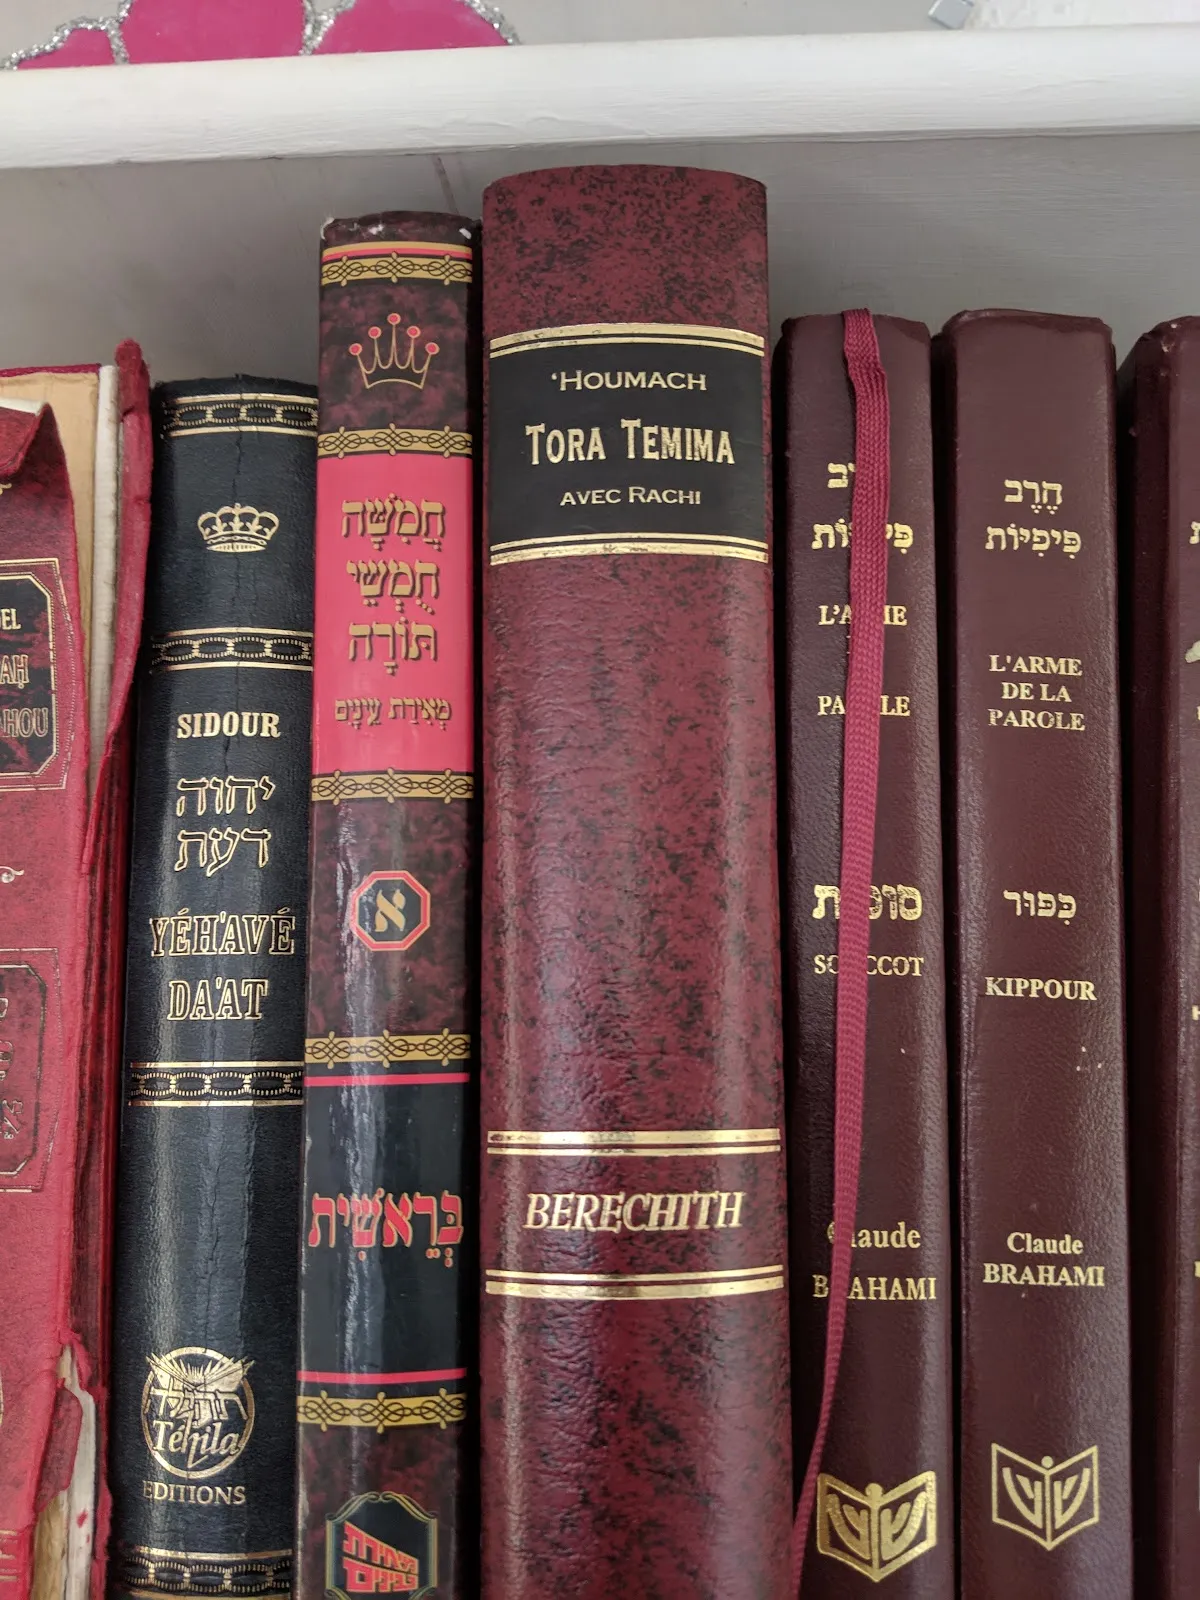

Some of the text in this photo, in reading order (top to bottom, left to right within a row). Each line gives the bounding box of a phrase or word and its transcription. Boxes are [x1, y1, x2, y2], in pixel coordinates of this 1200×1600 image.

[525, 418, 735, 465] TORA TEMIMA
[560, 486, 701, 506] AVEC RACHI
[989, 655, 1083, 676] L'ARME
[1001, 682, 1072, 702] DE LA
[817, 694, 911, 717] PALE
[177, 712, 281, 738] SIDOUR
[988, 708, 1086, 731] PAROLE
[174, 827, 271, 878] דעת
[374, 889, 406, 933] א
[167, 977, 269, 1021] DA'AT
[985, 976, 1098, 1001] KIPPOUR
[1006, 1231, 1084, 1255] Claude
[983, 1262, 1105, 1287] BRAHAMI
[812, 1274, 937, 1301] BAHAMI
[143, 1480, 246, 1505] EDITIONS
